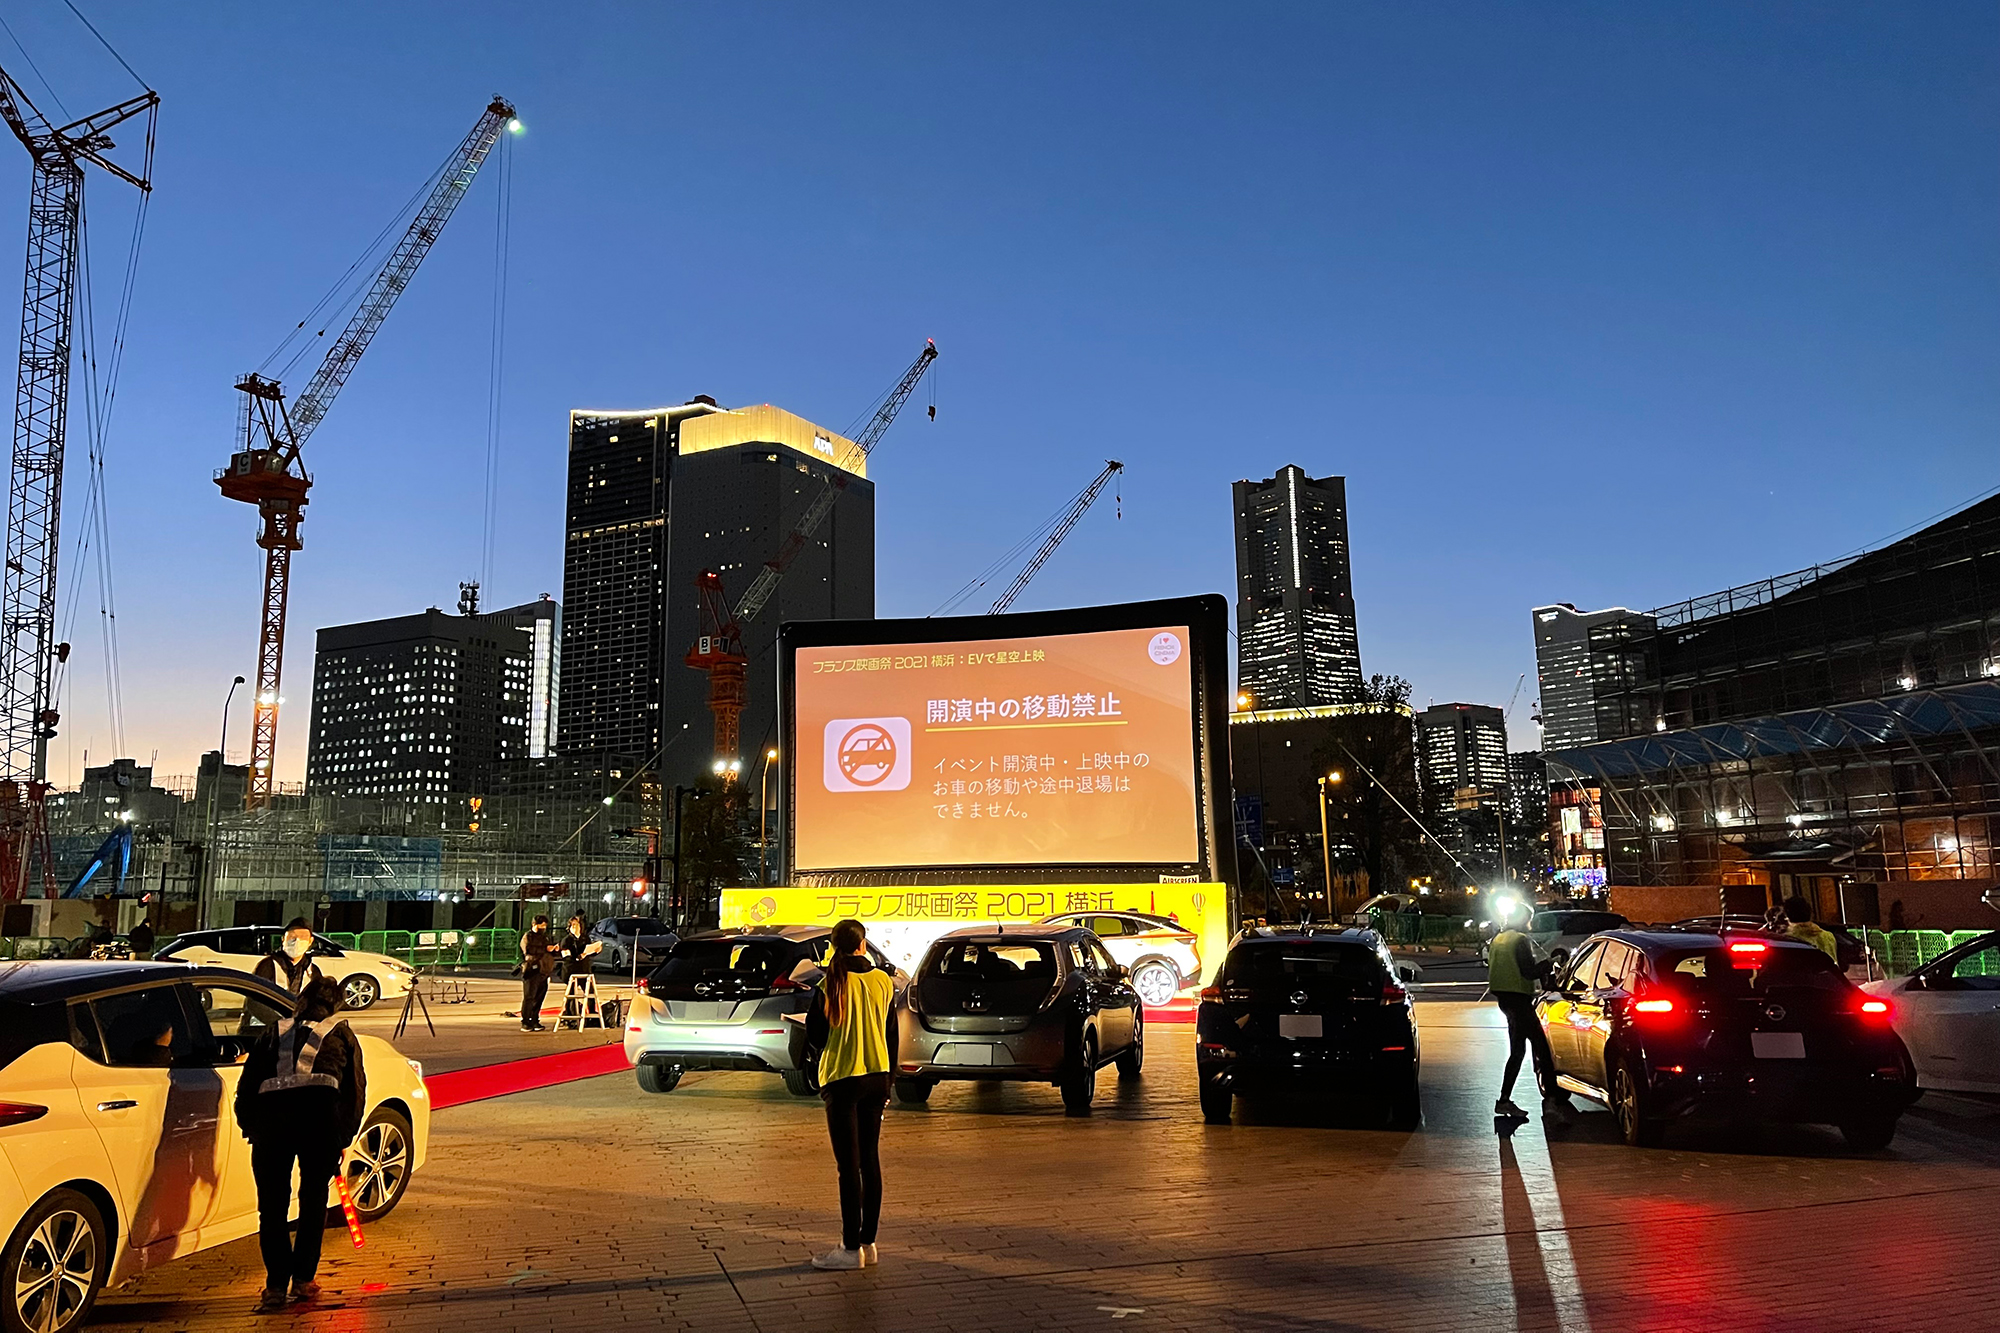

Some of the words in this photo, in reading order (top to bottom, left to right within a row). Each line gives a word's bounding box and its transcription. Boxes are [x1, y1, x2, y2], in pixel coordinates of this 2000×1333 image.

[240, 454, 249, 467] C
[701, 638, 708, 648] B
[813, 657, 892, 674] フランス映画祭
[894, 656, 928, 670] 2021
[926, 691, 1122, 724] 開演中の移動禁止
[933, 751, 1150, 774] イベント開演中・上映中の
[933, 775, 1131, 797] お車の移動や途中退場は
[933, 801, 1029, 819] できません。
[816, 892, 979, 917] フランス映画祭
[987, 892, 1054, 917] 2021
[1065, 891, 1114, 911] 横浜
